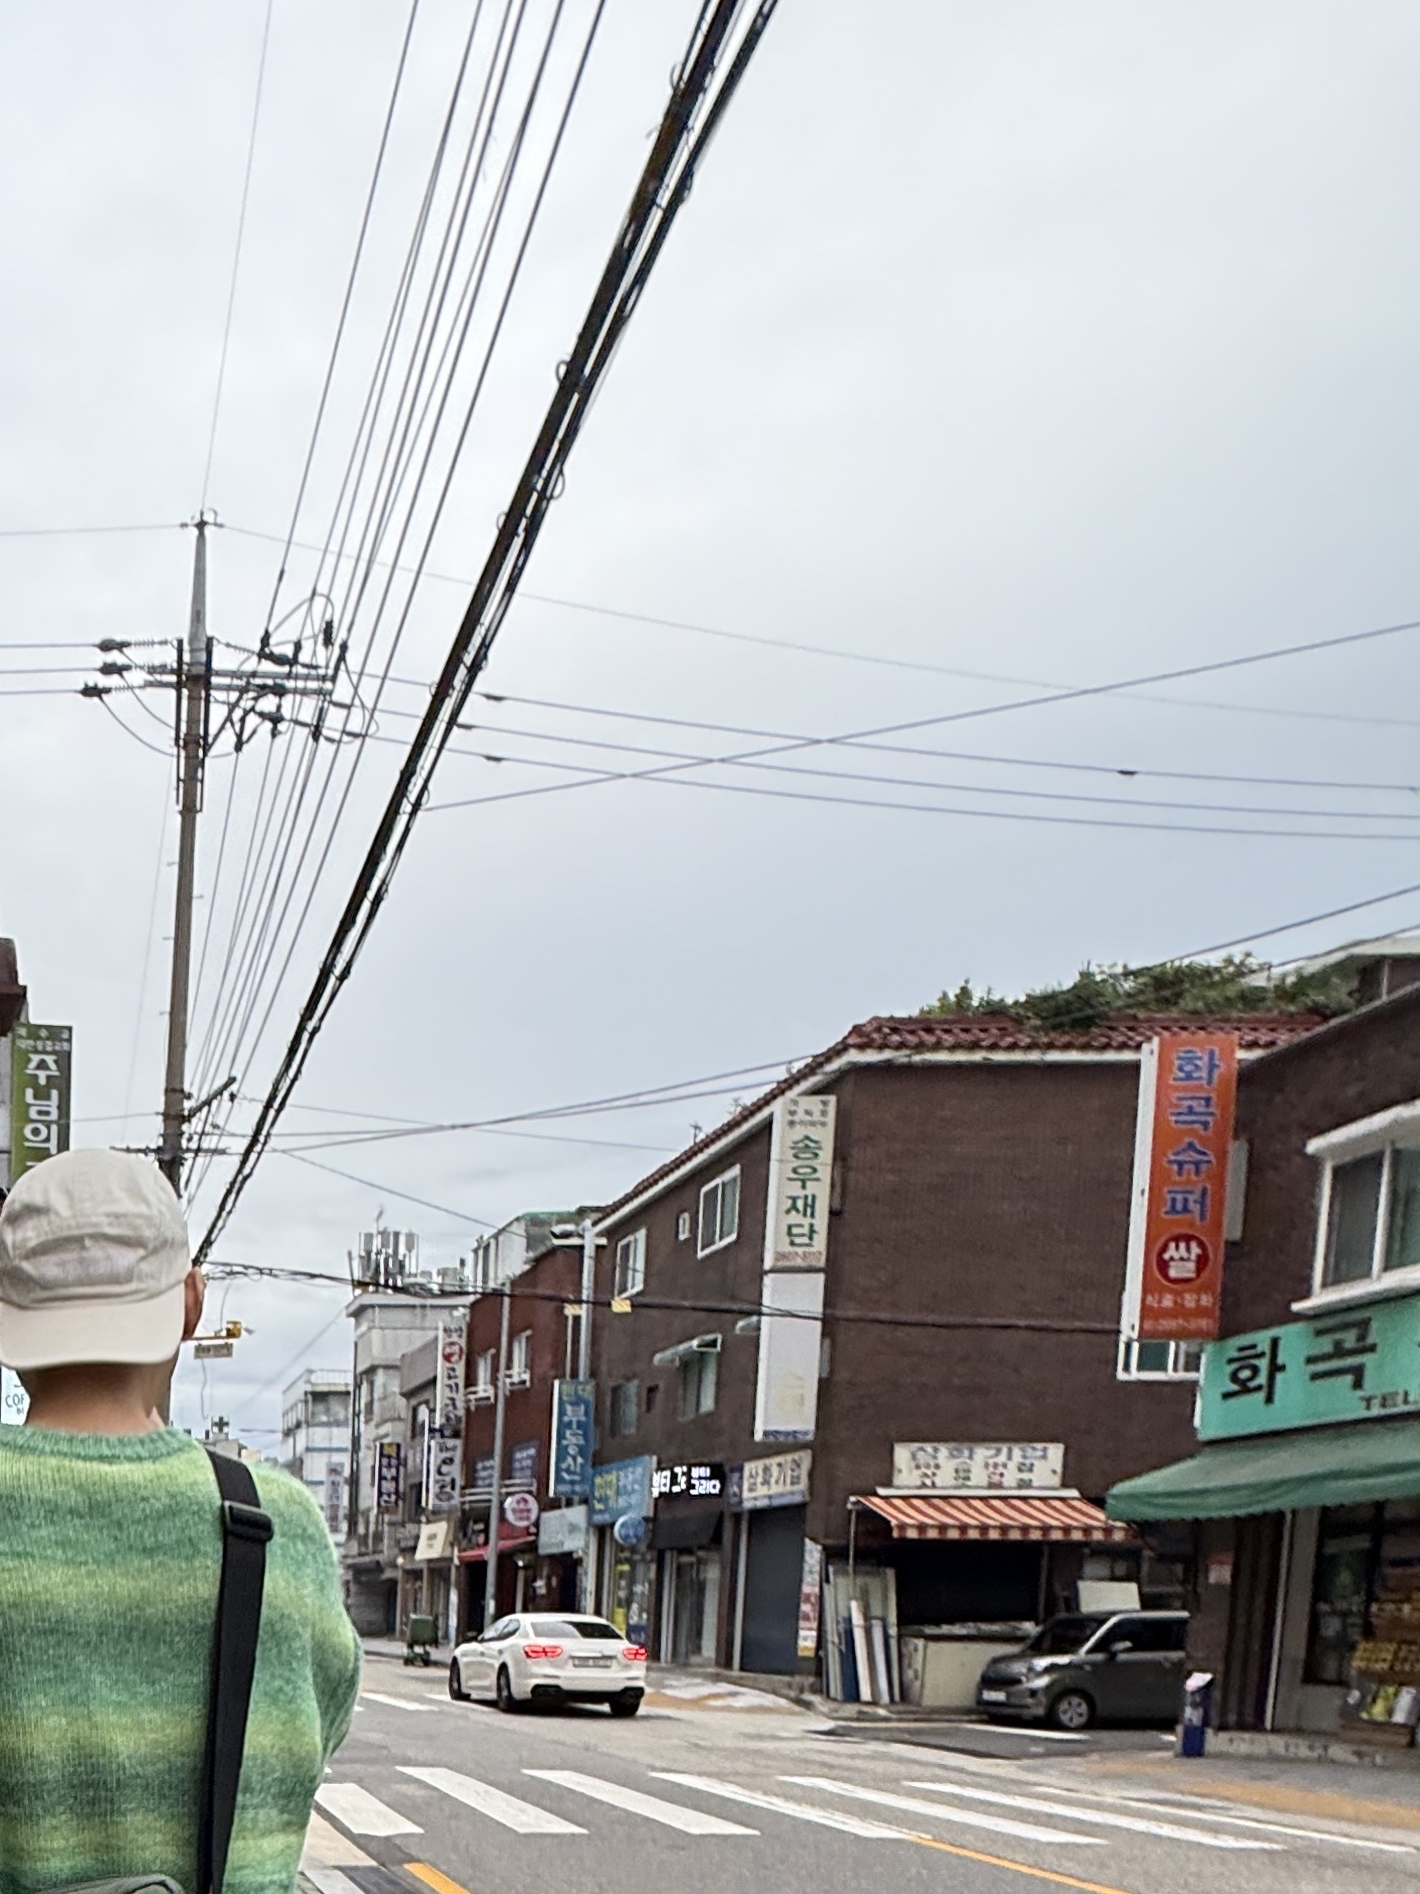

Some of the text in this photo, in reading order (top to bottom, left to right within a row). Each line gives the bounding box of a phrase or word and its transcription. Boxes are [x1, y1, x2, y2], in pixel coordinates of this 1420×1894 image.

[23, 1053, 60, 1155] 주님의
[1164, 1047, 1221, 1224] 화곡슈퍼
[784, 1134, 823, 1247] 송우재단
[1164, 1241, 1202, 1279] 쌀
[1221, 1318, 1420, 1405] 화곡
[561, 1403, 586, 1480] 부동산
[689, 1478, 721, 1496] 그리다
